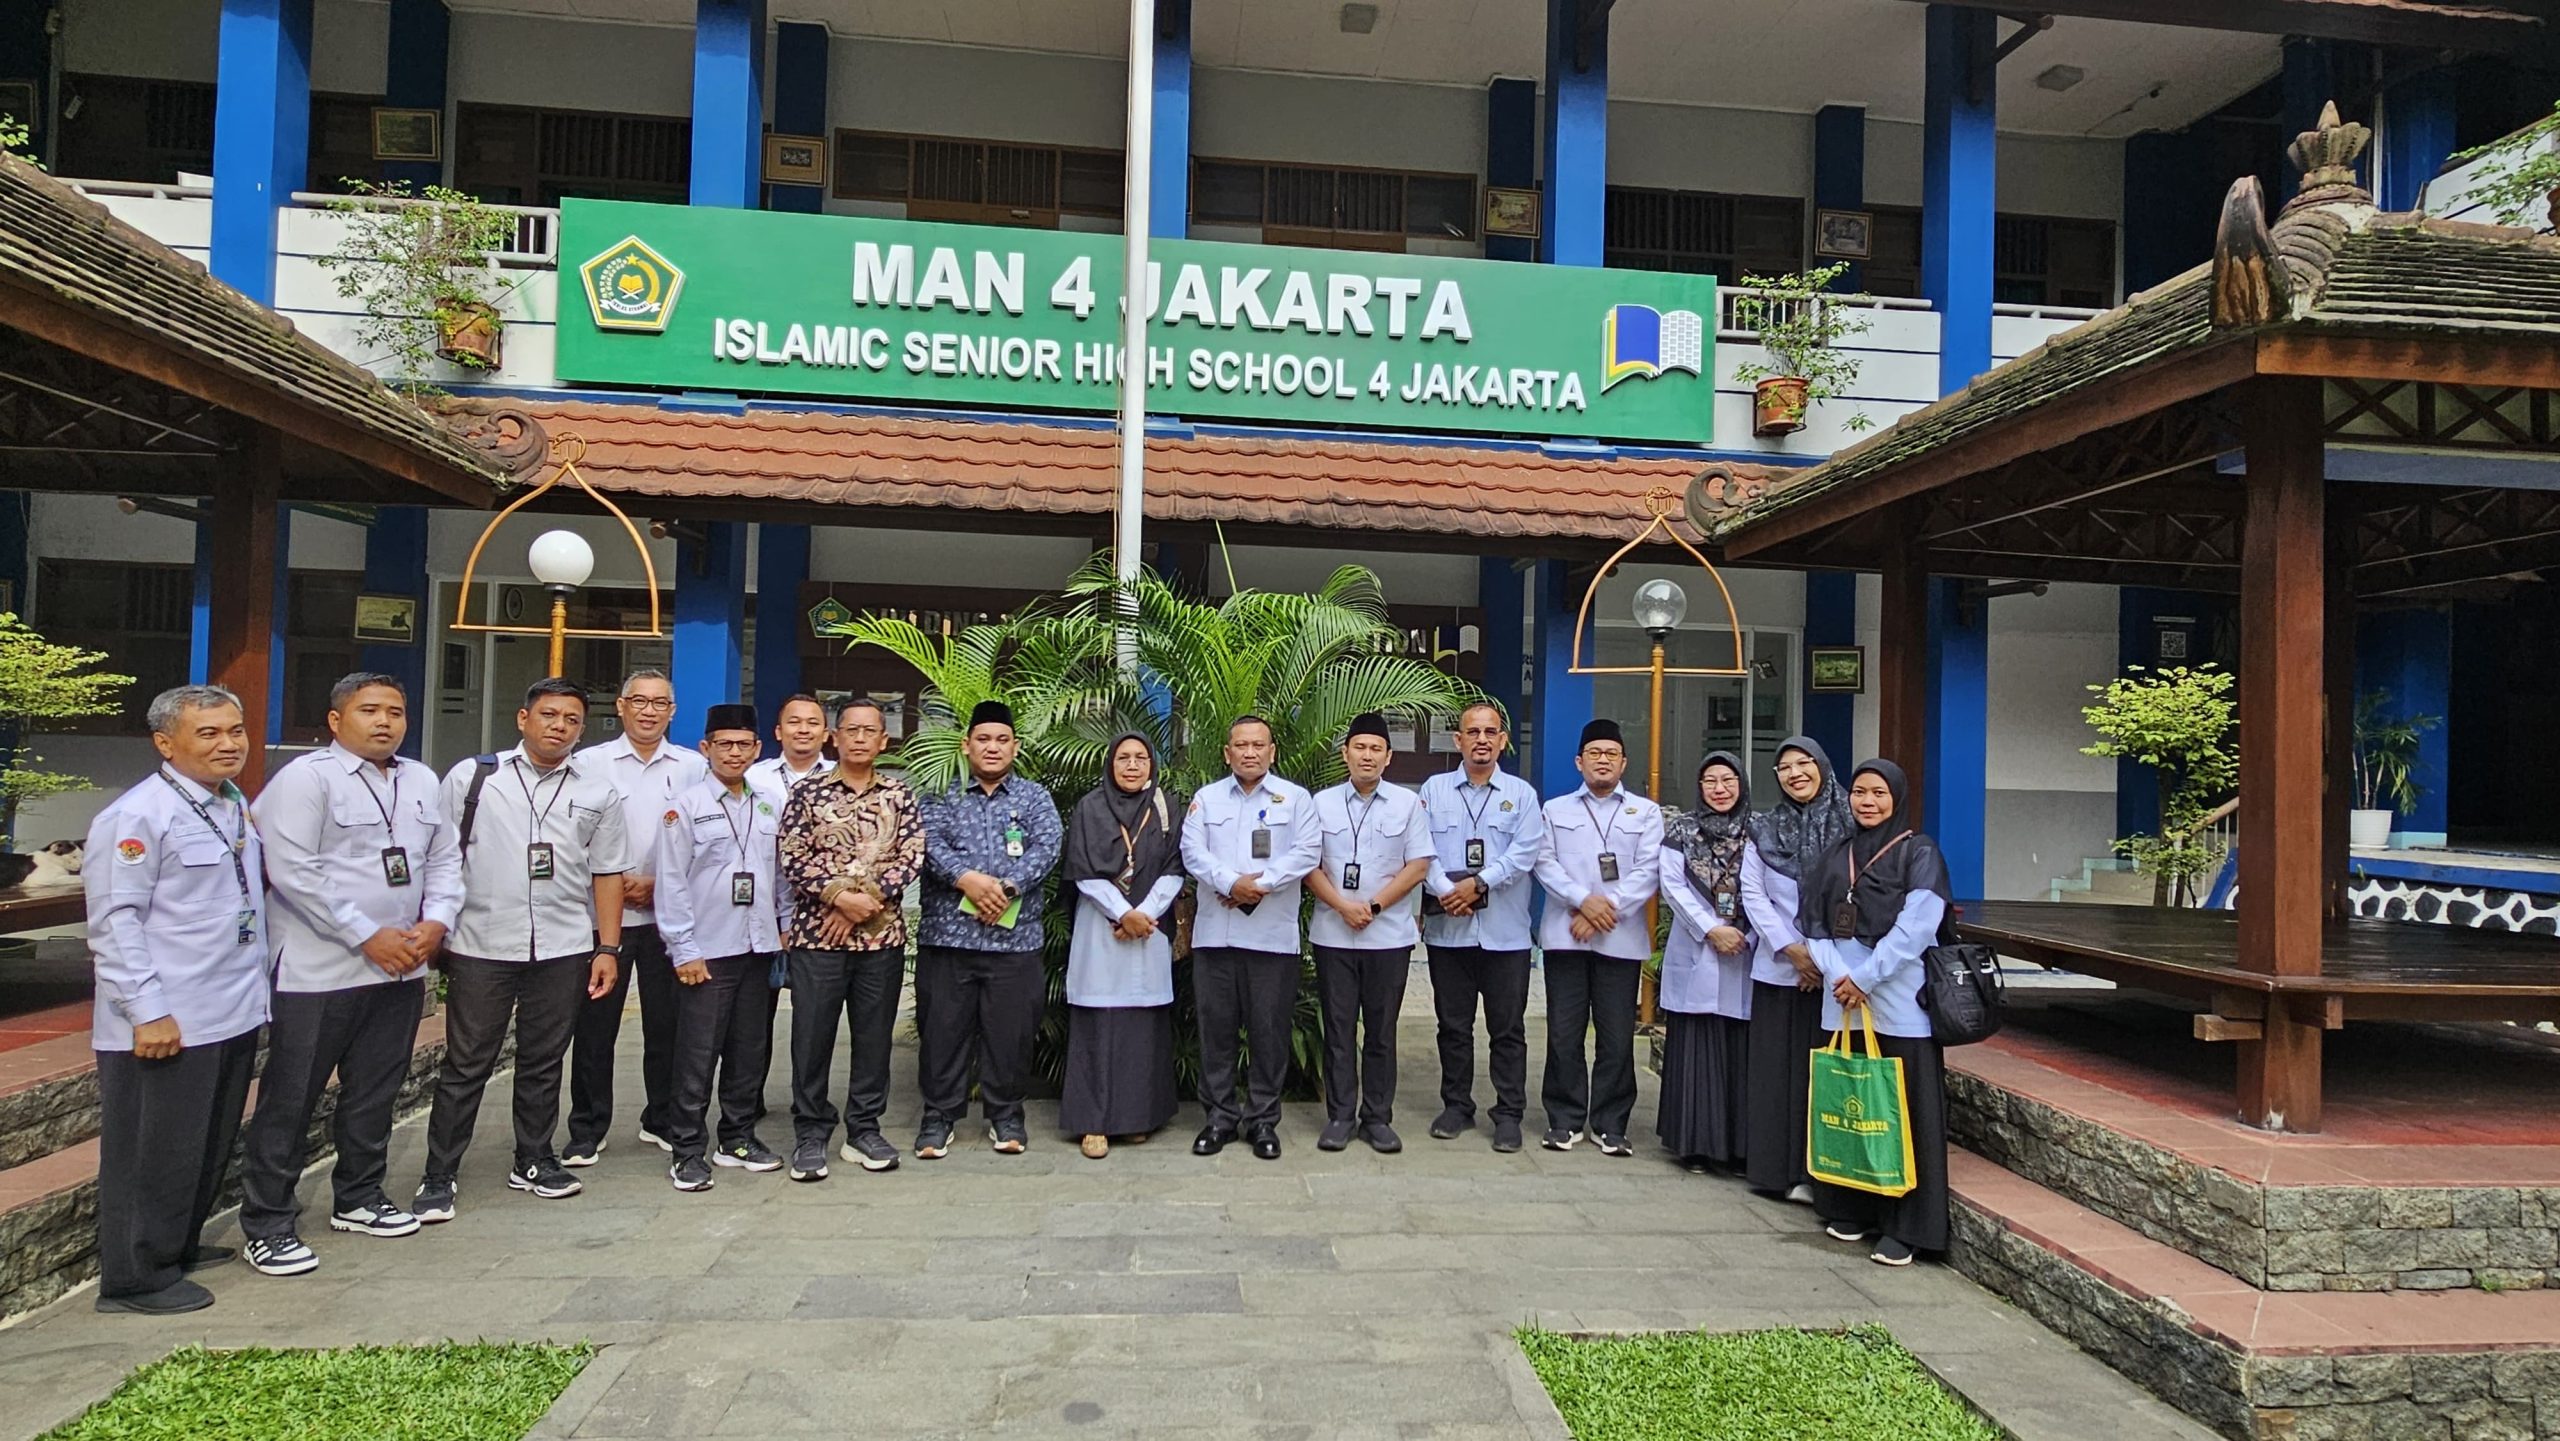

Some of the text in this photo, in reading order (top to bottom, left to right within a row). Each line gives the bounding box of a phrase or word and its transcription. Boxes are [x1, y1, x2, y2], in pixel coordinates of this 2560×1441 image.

[852, 242, 1472, 342] MAN 4 JAKARTA
[713, 317, 890, 369] ISLAMIC
[901, 331, 1063, 381] SENIOR
[1187, 347, 1358, 399] SCHOOL
[1367, 360, 1391, 401] 4
[1400, 363, 1588, 411] JAKARTA
[1820, 1112, 1840, 1125] MAN
[1852, 1120, 1890, 1132] JAKARTA
